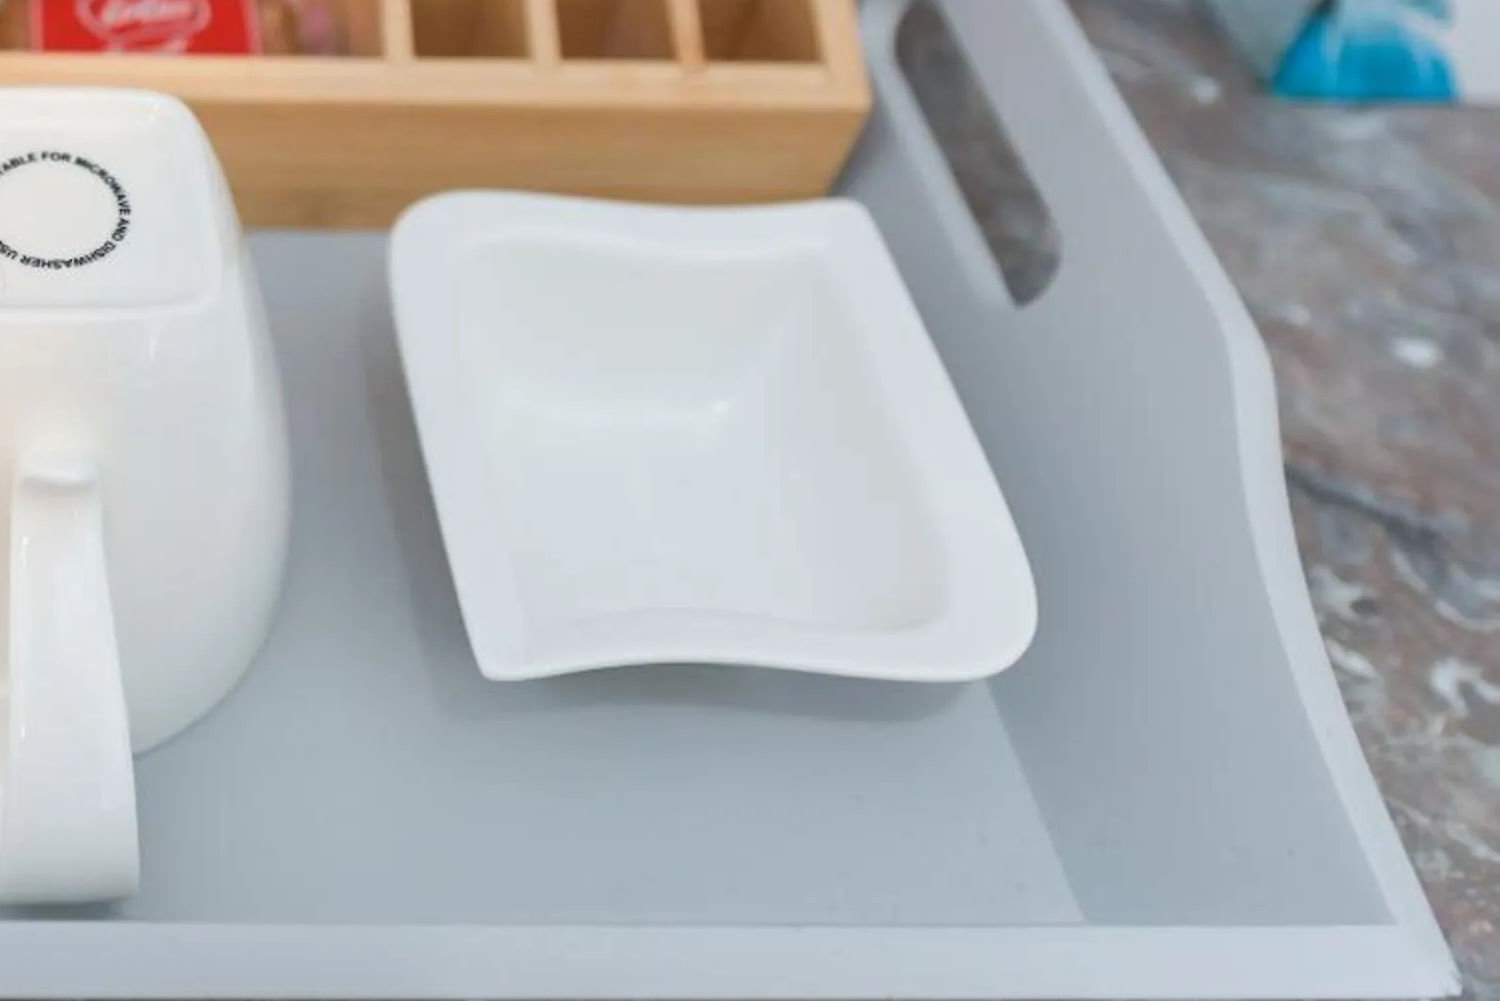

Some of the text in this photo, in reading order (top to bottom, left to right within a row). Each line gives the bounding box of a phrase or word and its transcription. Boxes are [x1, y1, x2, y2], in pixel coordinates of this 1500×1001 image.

[41, 151, 72, 162] FOR
[74, 156, 131, 215] MICROWAVE
[111, 217, 130, 242] AND
[19, 241, 116, 270] DISHWASHER
